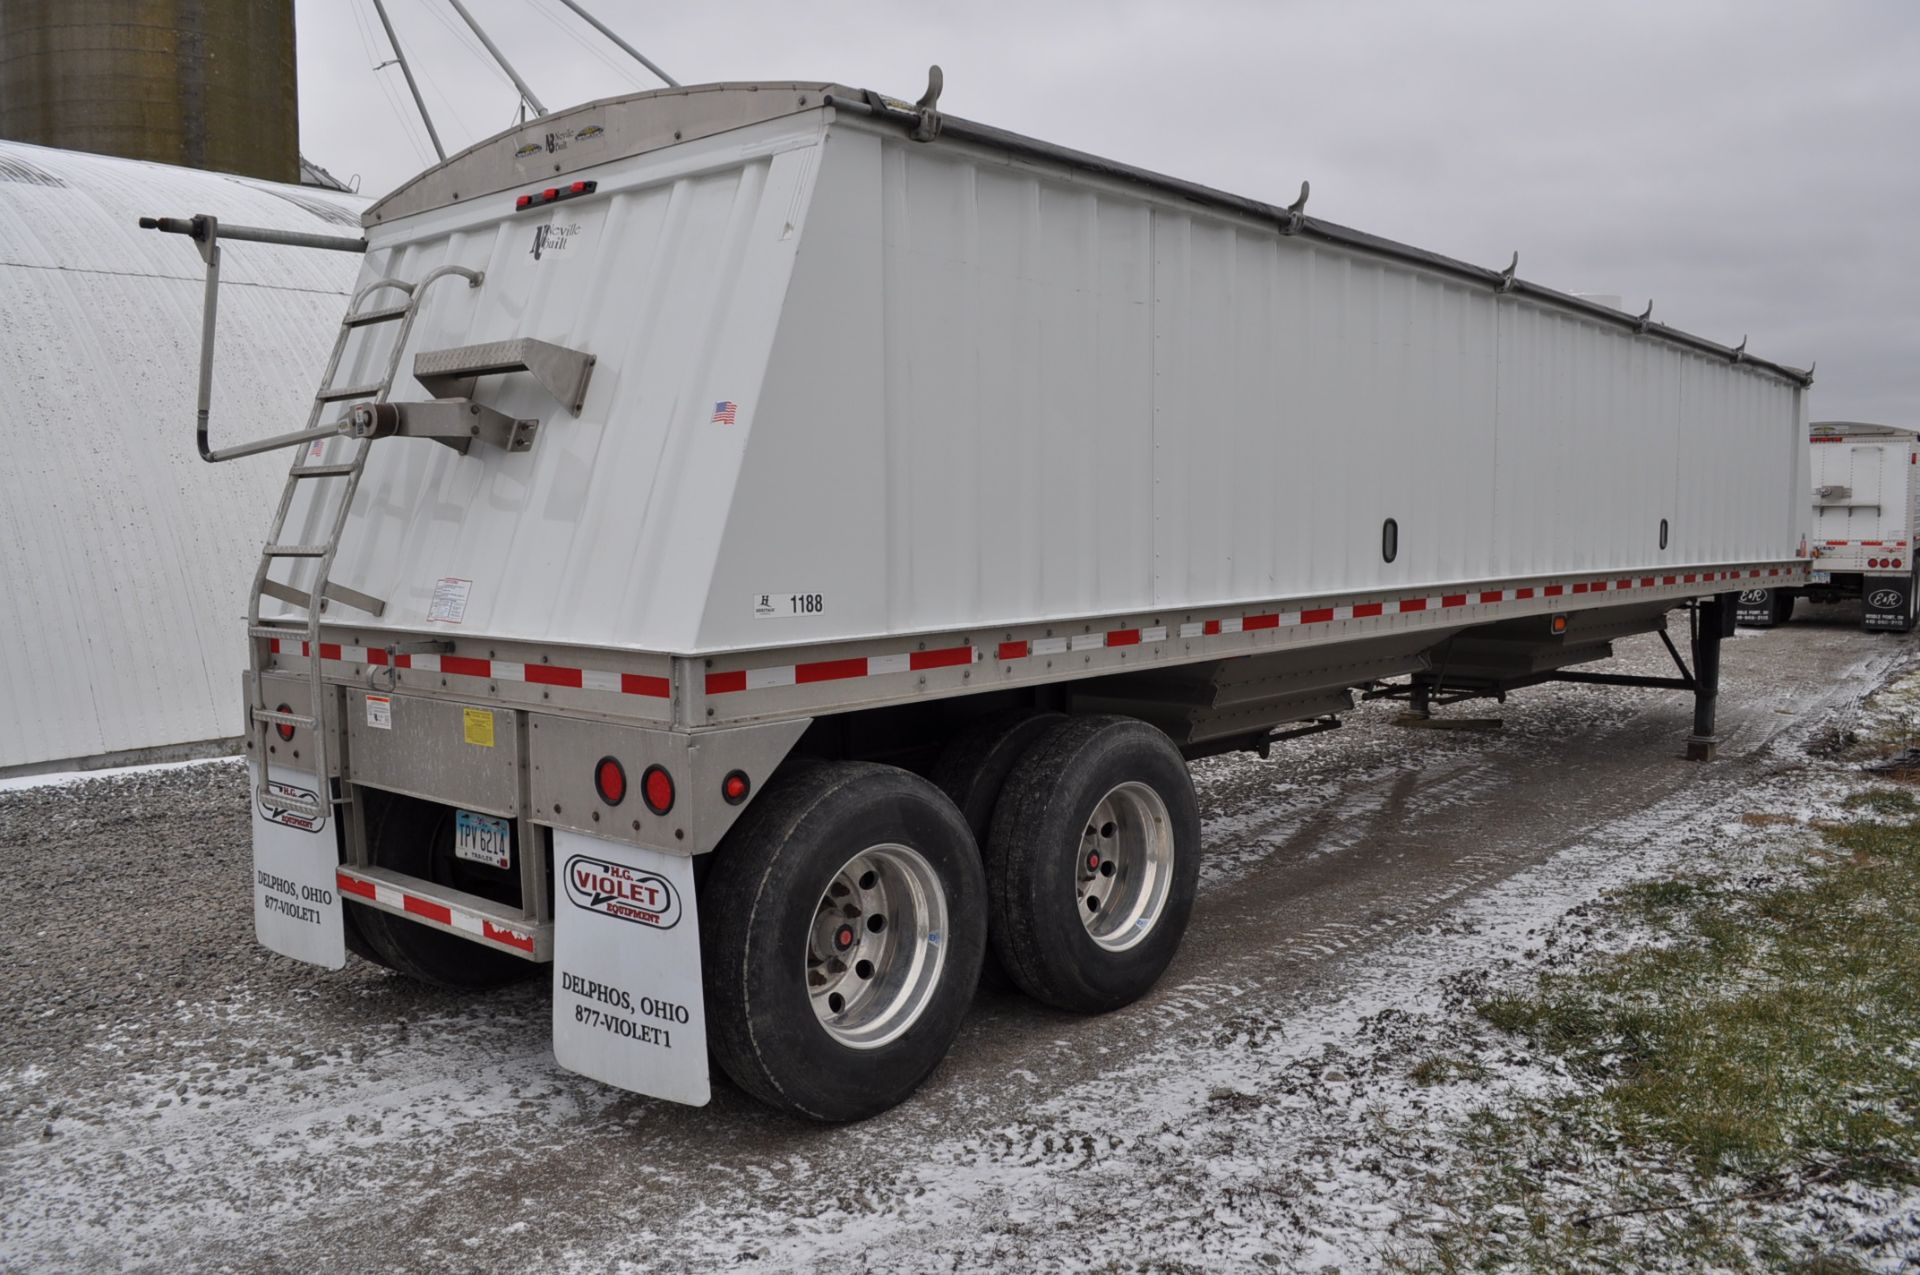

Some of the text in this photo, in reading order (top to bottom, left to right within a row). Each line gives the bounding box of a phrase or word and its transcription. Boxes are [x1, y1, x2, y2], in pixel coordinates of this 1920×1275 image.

[790, 593, 823, 614] 1188
[459, 823, 506, 857] TPV 6214
[257, 869, 332, 906] DELPHOS, OHIO
[576, 869, 659, 906] VIOLET
[610, 866, 634, 882] H.G.
[264, 894, 321, 924] 877-VIOLET1
[606, 902, 660, 924] EQUIPMENT
[562, 971, 690, 1024] DELPHOS, OHIO
[575, 1004, 672, 1048] 877-VIOLET1
